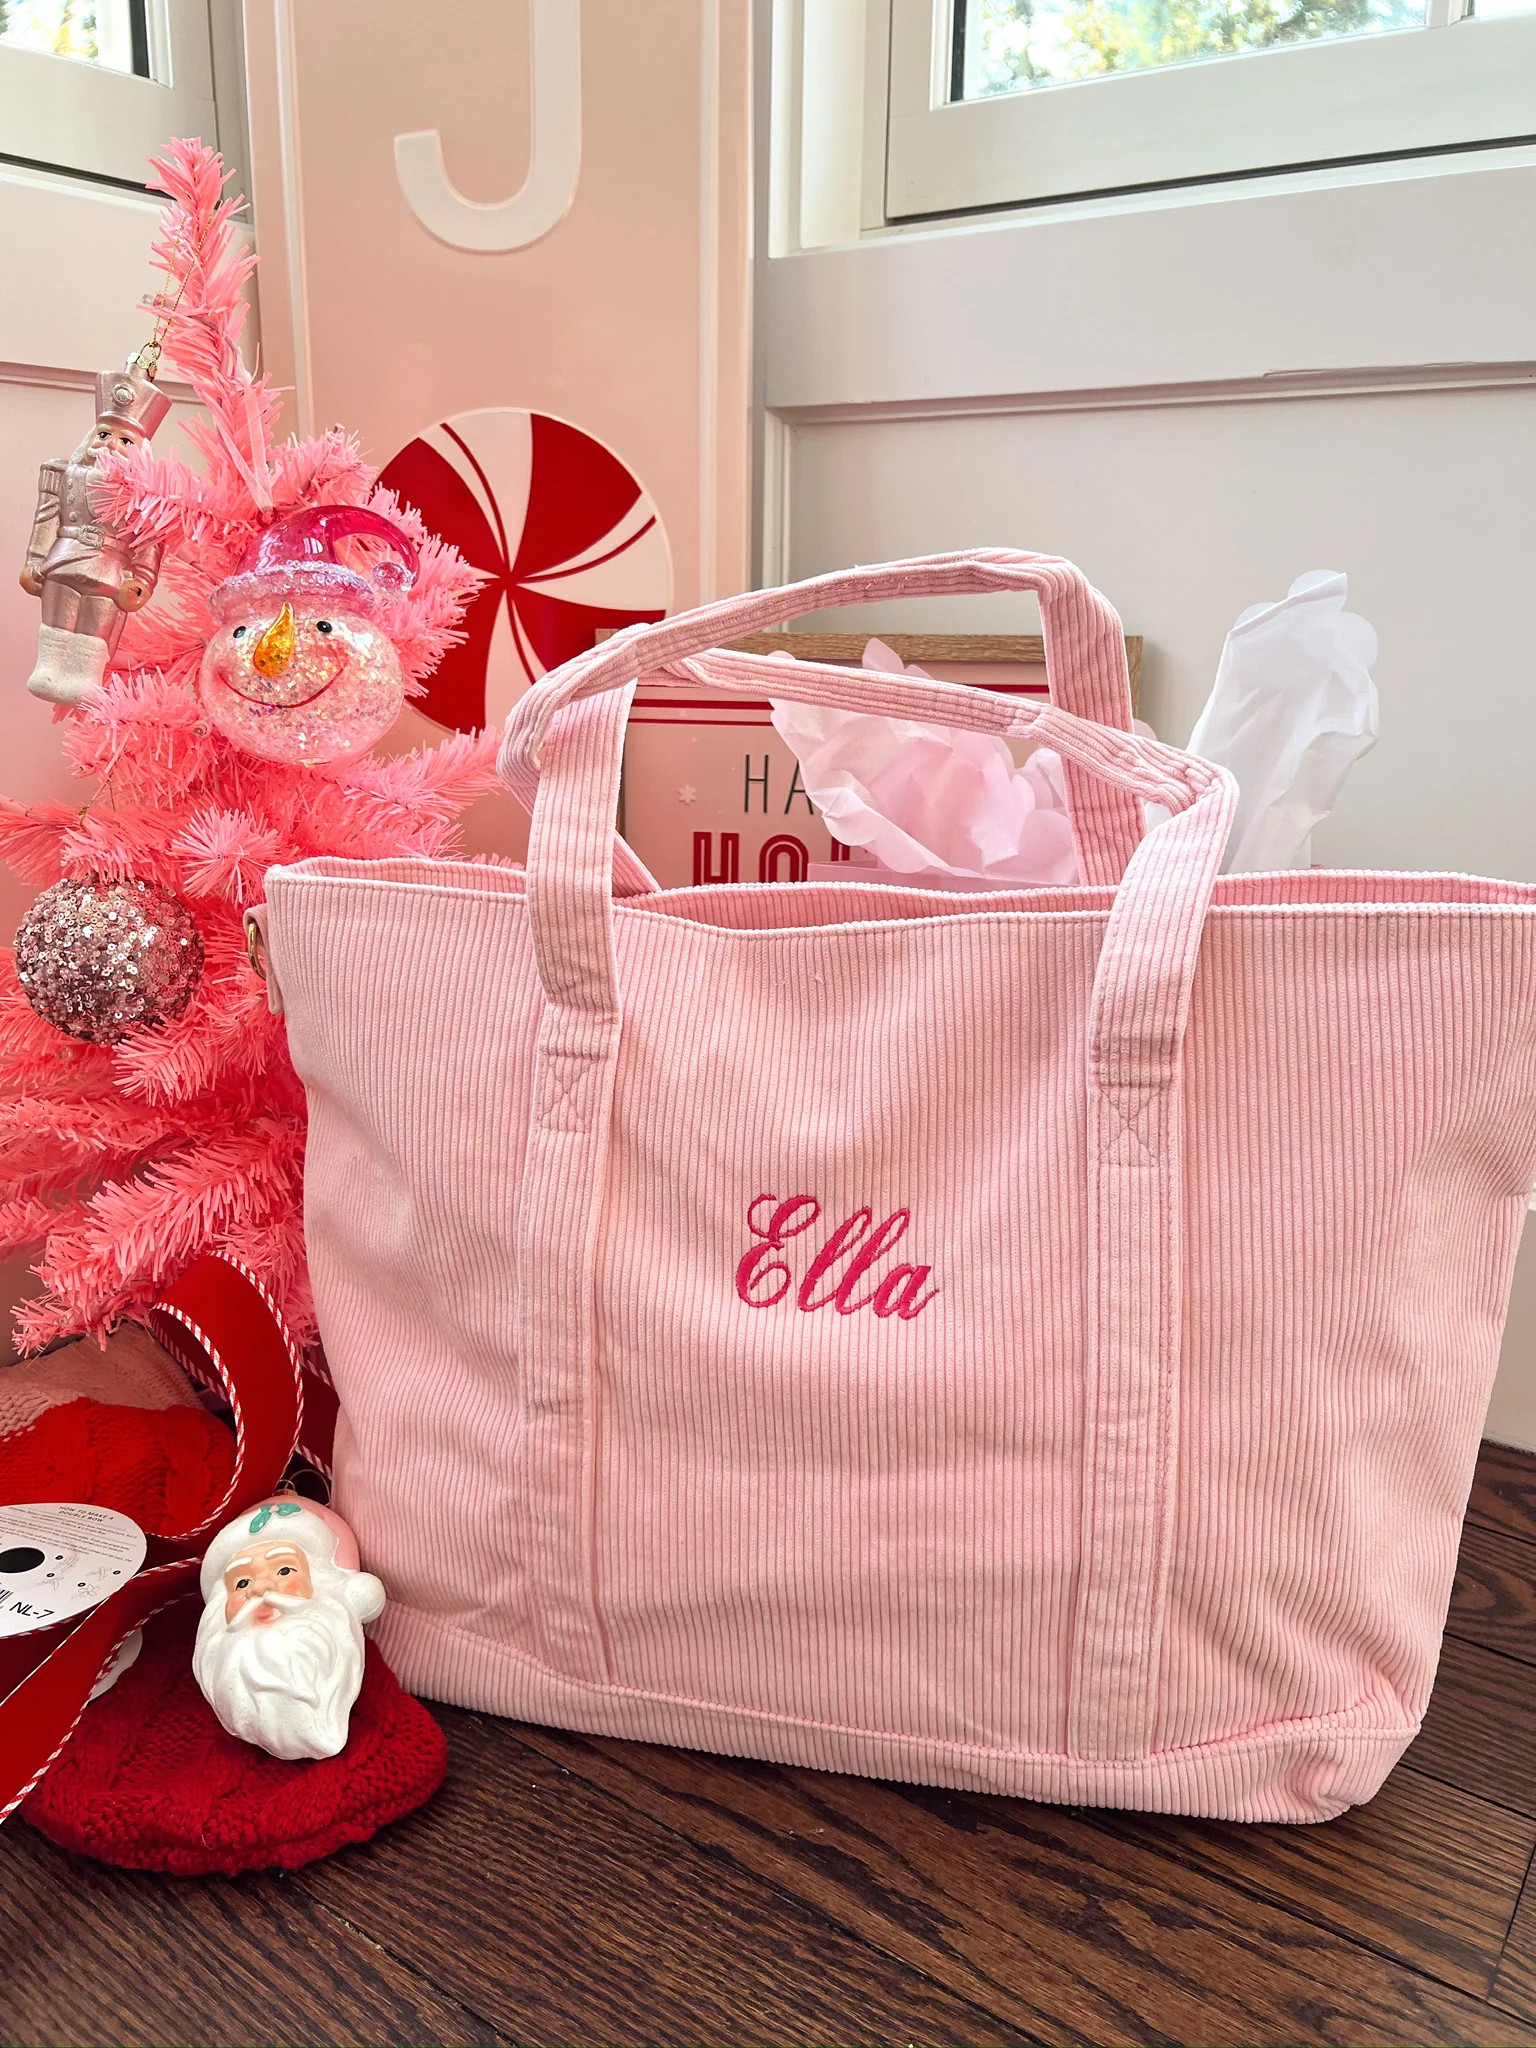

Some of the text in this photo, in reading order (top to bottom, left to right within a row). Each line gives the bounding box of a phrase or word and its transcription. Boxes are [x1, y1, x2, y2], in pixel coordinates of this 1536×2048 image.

[394, 0, 581, 251] J
[736, 1194, 940, 1320] Ella
[58, 1510, 87, 1518] DOUBLE
[87, 1511, 108, 1519] MAKE
[9, 1602, 55, 1619] NL-7
